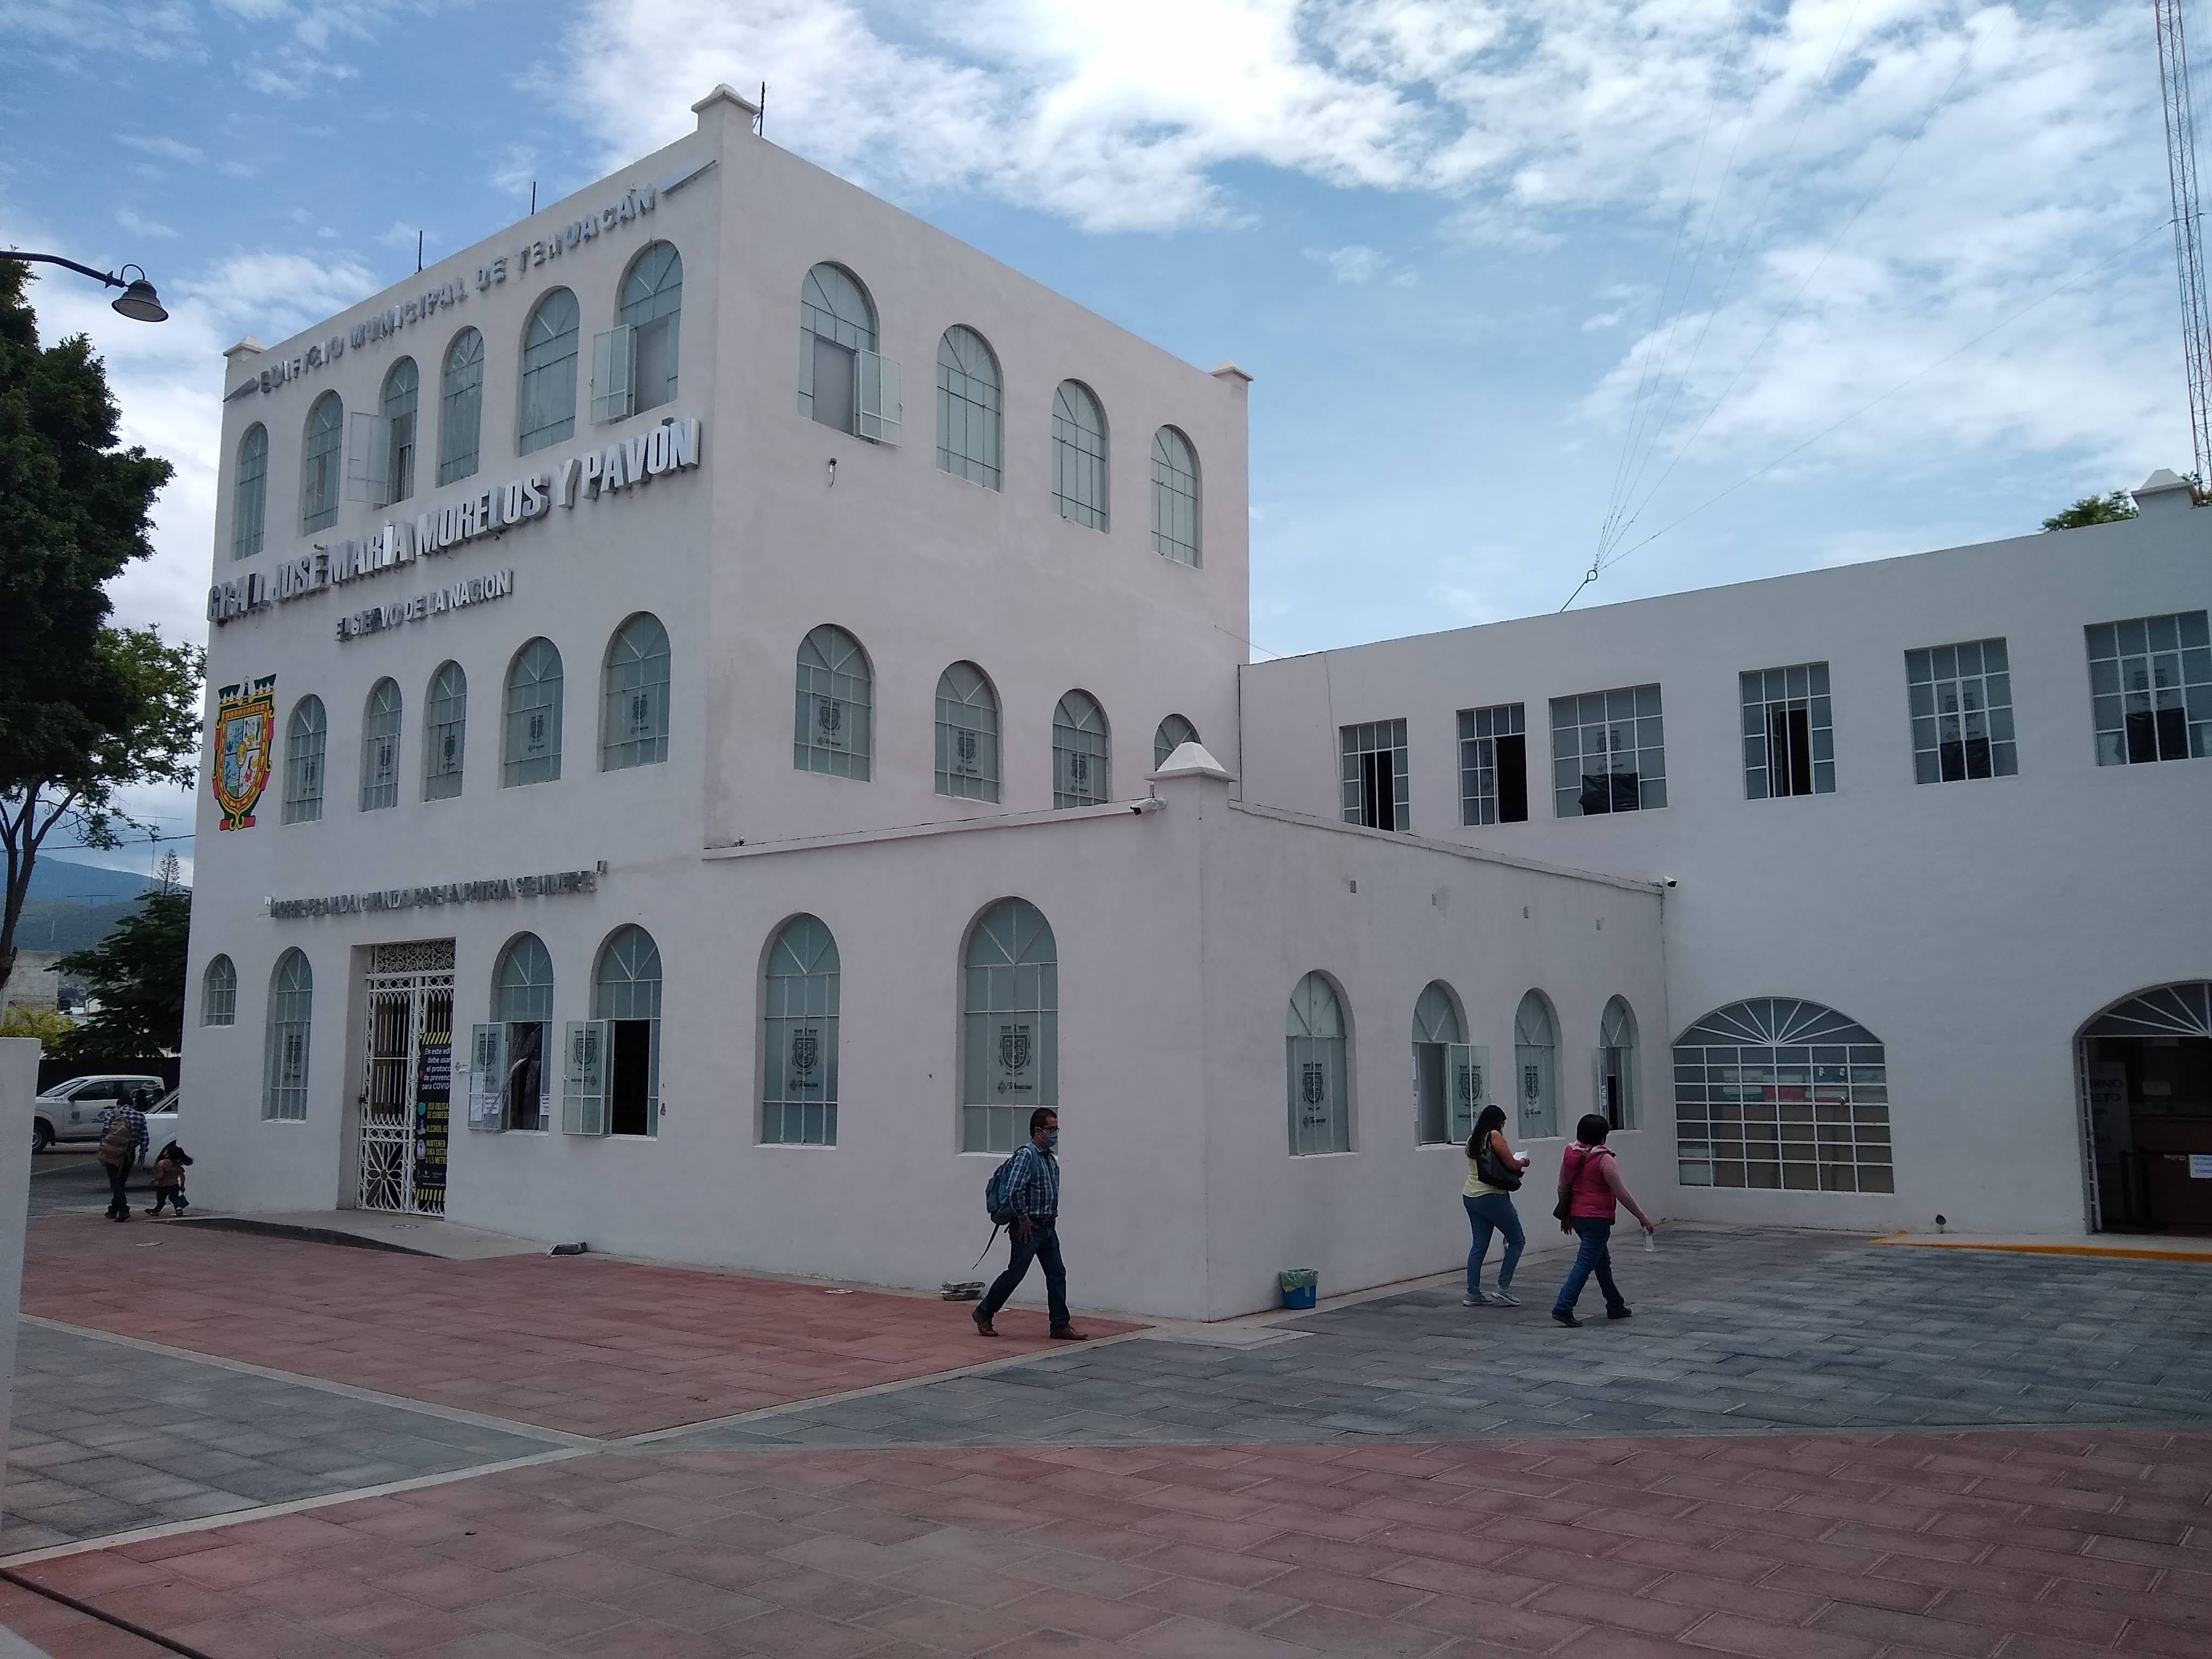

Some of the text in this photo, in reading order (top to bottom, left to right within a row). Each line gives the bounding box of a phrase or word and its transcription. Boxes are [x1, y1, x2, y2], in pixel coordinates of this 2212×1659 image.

[261, 335, 345, 394] EDIFICIO
[350, 276, 468, 350] MUNICIPAL
[476, 255, 508, 292] DE
[416, 472, 550, 557] MORELOS
[557, 458, 582, 509] Y
[582, 416, 700, 501] PAVÓN
[404, 595, 427, 622] DE
[427, 589, 449, 615] LA
